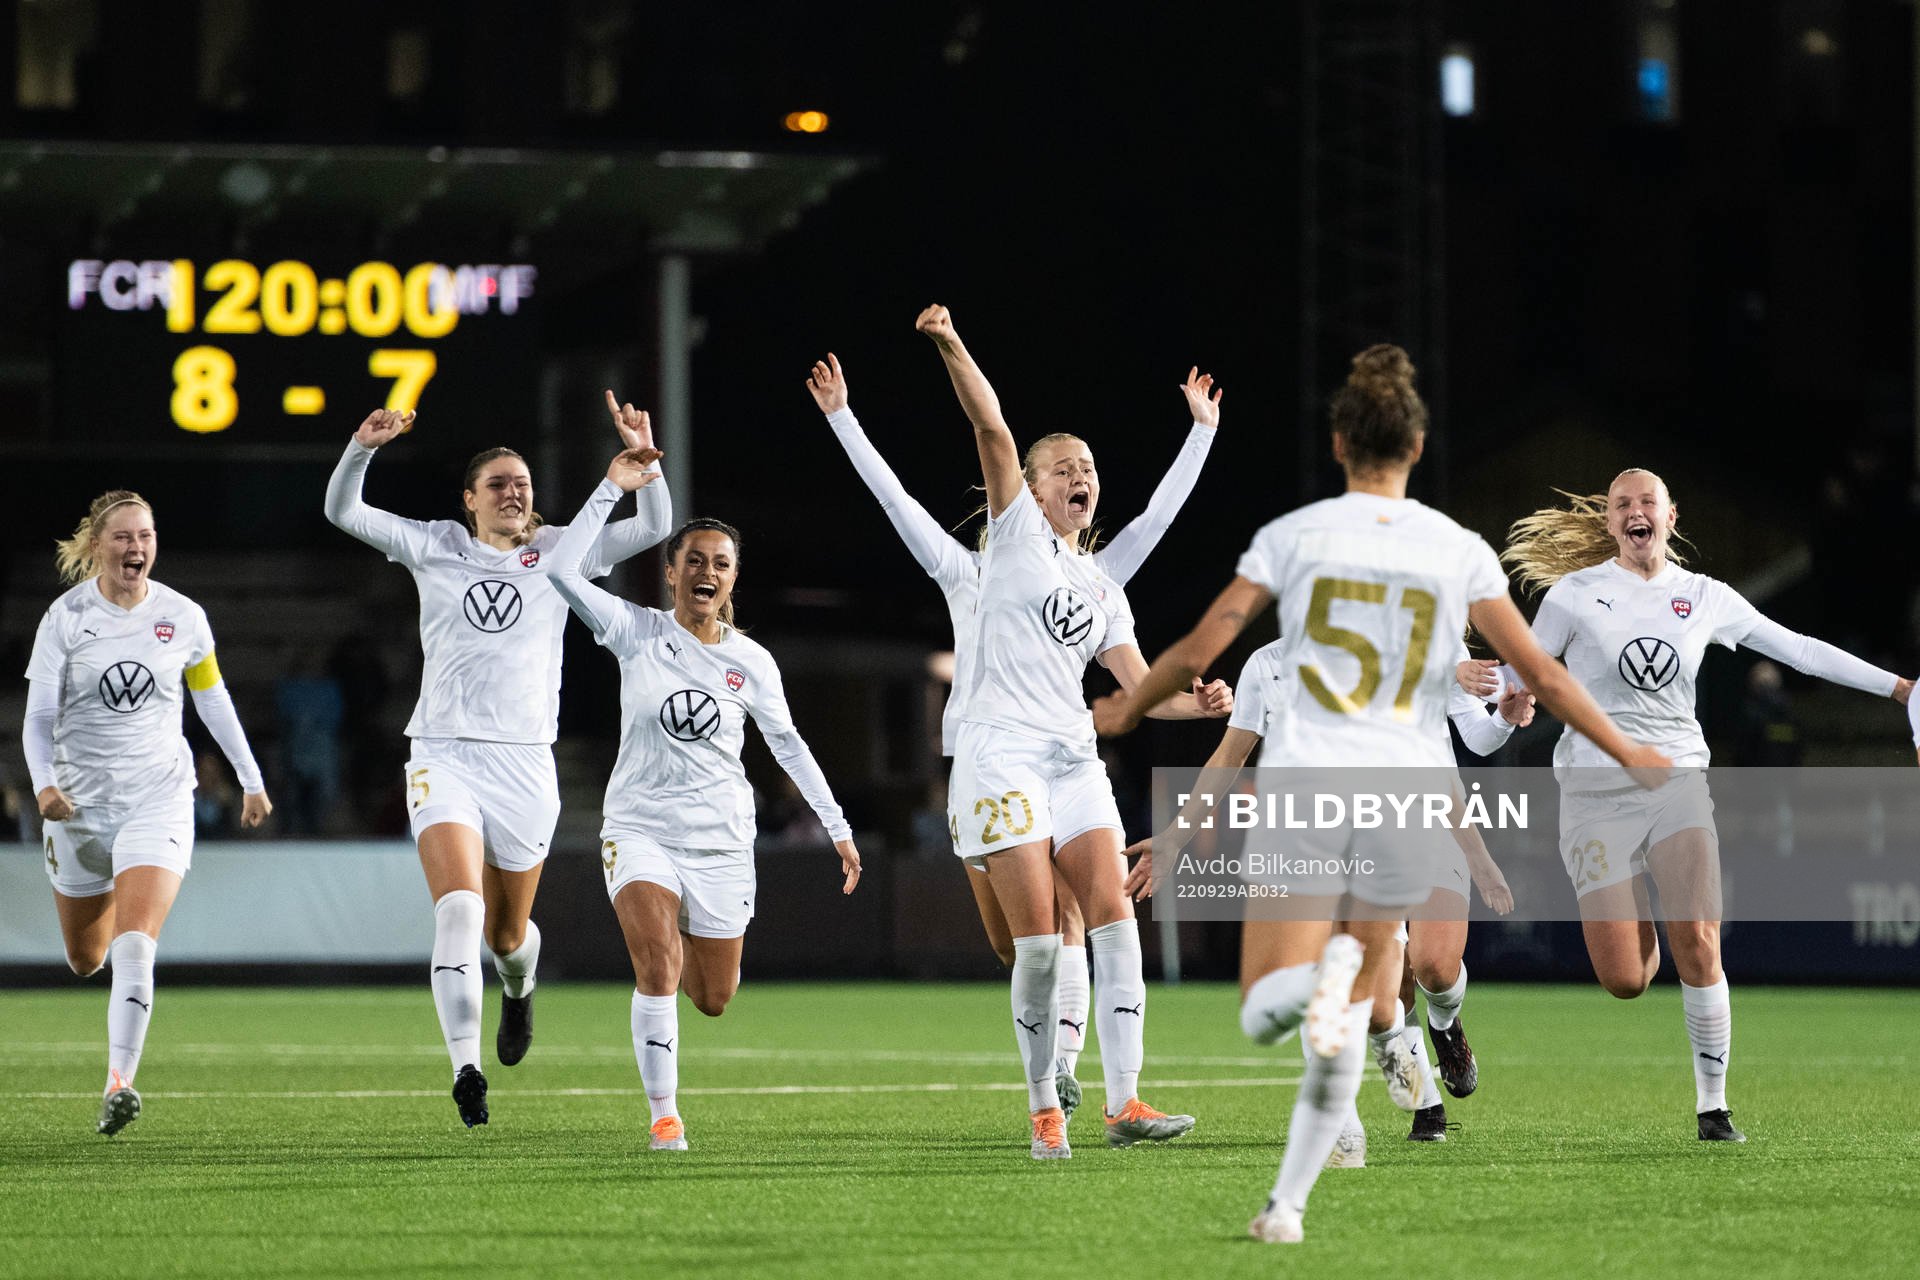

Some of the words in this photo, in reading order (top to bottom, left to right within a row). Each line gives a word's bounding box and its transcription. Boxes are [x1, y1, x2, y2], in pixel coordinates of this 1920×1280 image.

[166, 258, 459, 338] 120:00
[172, 346, 237, 431] 8
[370, 350, 436, 432] 7
[1673, 601, 1690, 611] FCR
[156, 626, 173, 634] FCR
[1299, 576, 1437, 714] 51
[728, 673, 744, 684] FCR
[411, 767, 430, 809] 5
[974, 790, 1034, 844] 20
[45, 835, 59, 875] 4
[601, 840, 618, 882] 9
[1571, 839, 1609, 890] 23
